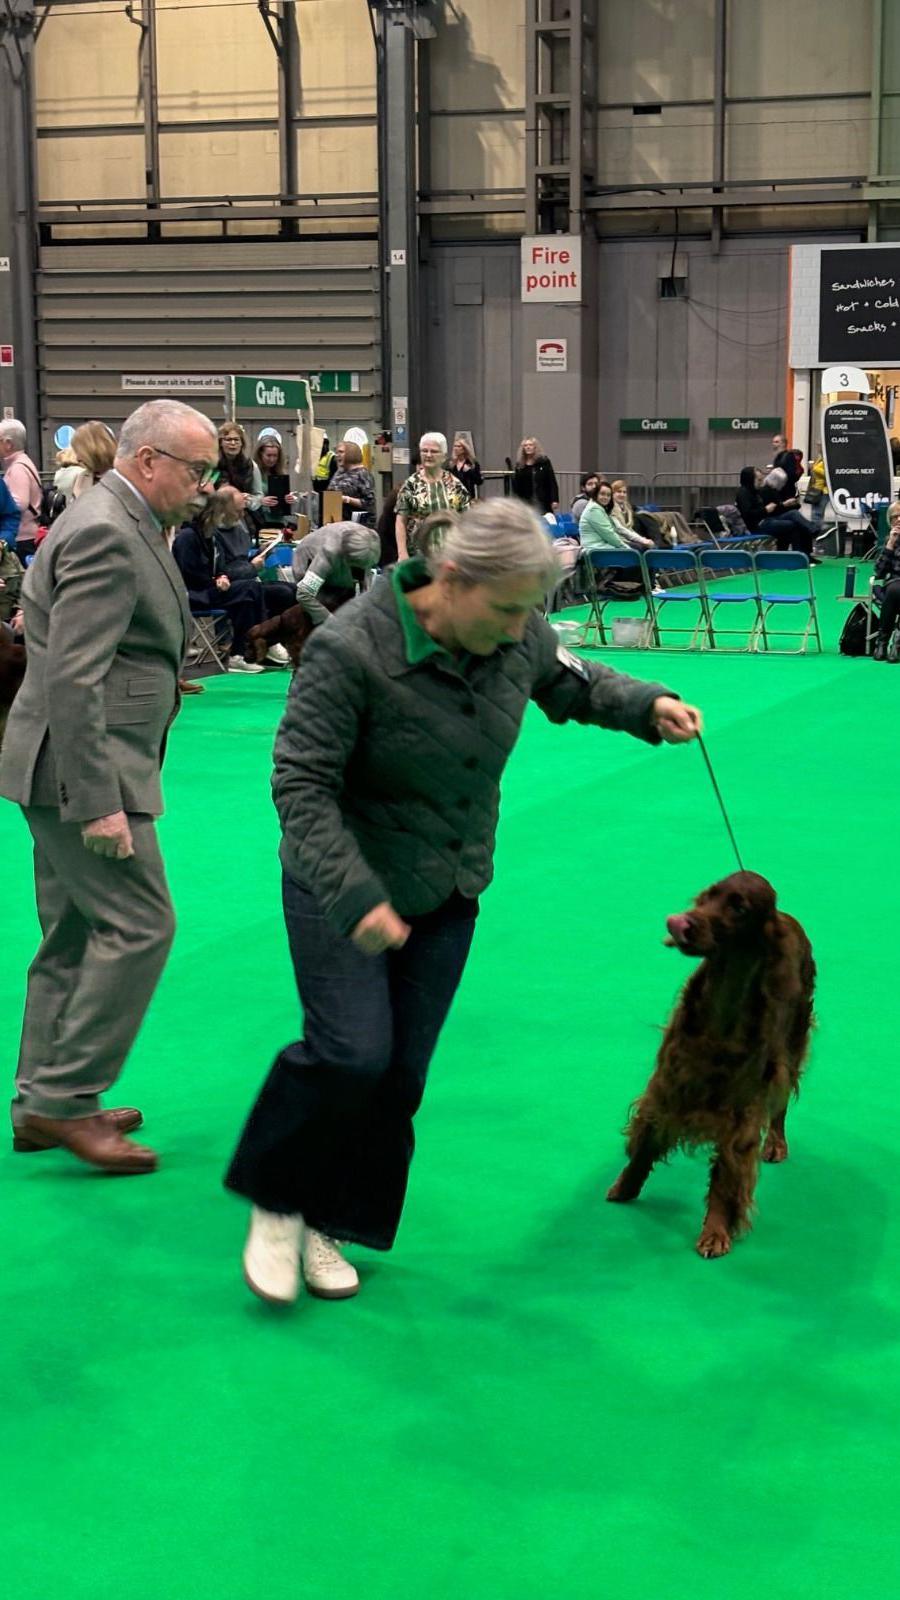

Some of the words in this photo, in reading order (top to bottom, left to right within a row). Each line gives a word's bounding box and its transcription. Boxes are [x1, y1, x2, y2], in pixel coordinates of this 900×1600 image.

[532, 247, 570, 264] Fire
[526, 271, 577, 292] point
[832, 276, 895, 290] Sandwiches
[836, 301, 859, 312] Hot
[874, 296, 900, 308] Cold
[848, 320, 886, 334] Snacks
[840, 373, 850, 387] 3
[256, 380, 285, 406] Crufts
[641, 420, 668, 430] Crufts
[732, 418, 759, 430] Crufts
